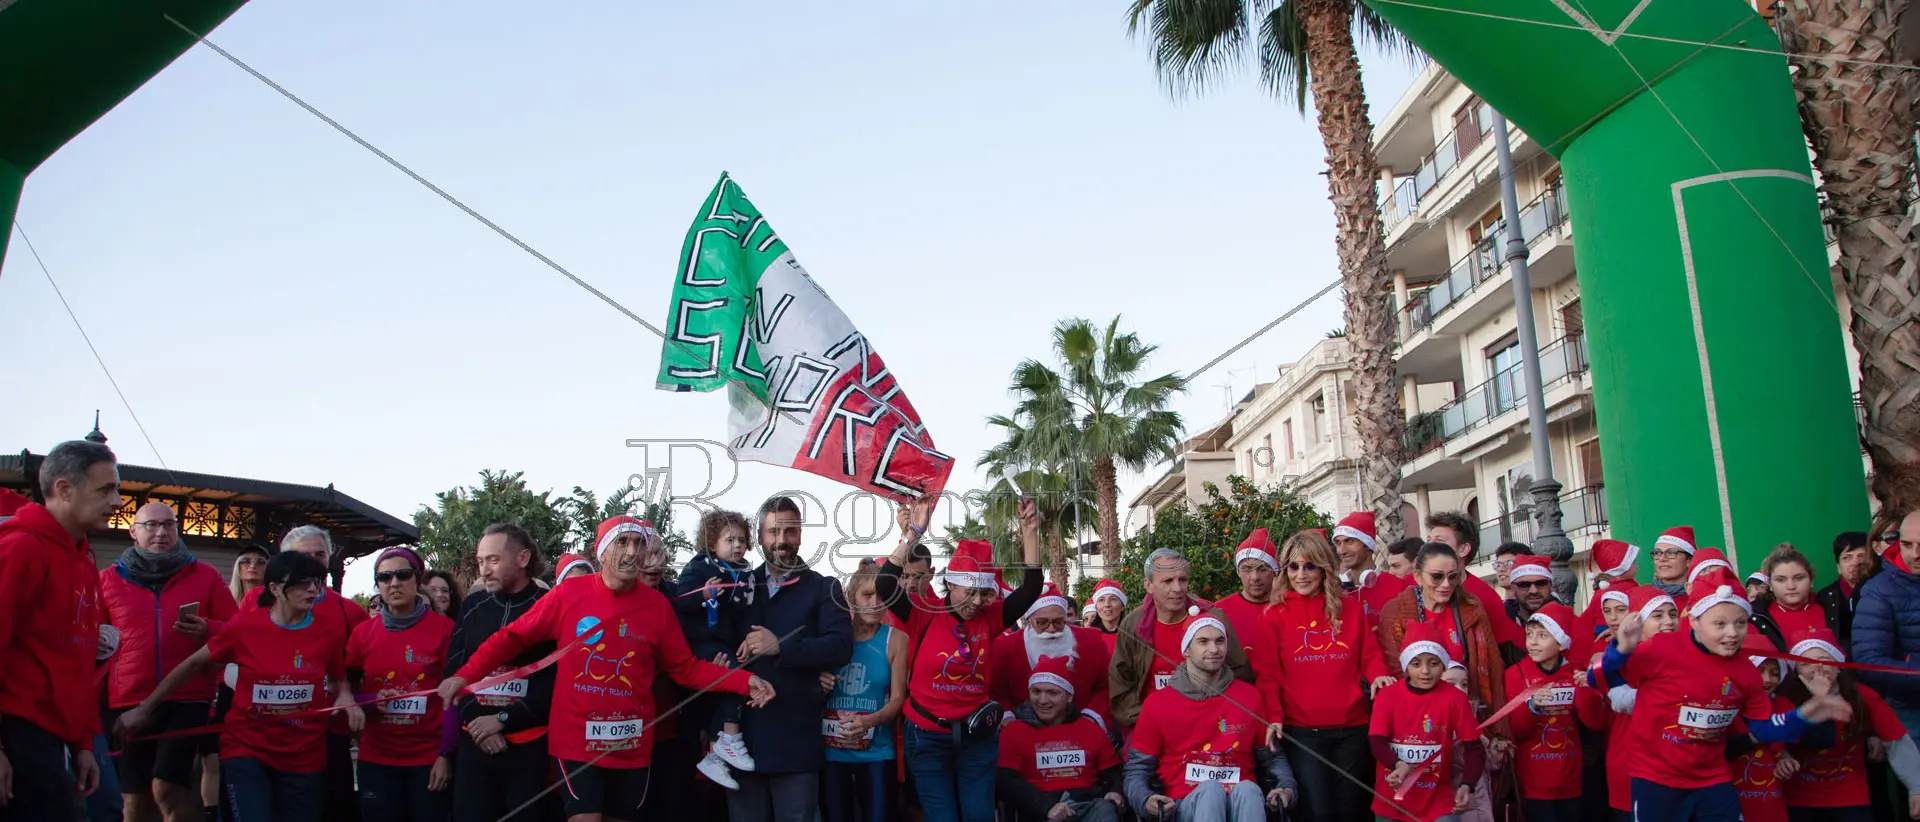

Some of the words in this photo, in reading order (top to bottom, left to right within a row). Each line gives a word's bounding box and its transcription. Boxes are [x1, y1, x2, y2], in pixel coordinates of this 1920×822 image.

[1294, 654, 1327, 665] HAPPY
[1329, 652, 1351, 661] RUN
[573, 682, 607, 697] HAPPY
[609, 688, 633, 698] RUN
[932, 682, 964, 693] HAPPY
[277, 688, 308, 701] 0266
[393, 699, 420, 710] 0371
[985, 710, 999, 726] GV
[610, 723, 637, 736] 0796
[1056, 753, 1081, 765] 0725
[1407, 749, 1436, 760] 0174
[1208, 770, 1234, 780] 0667
[1739, 790, 1769, 802] APPY
